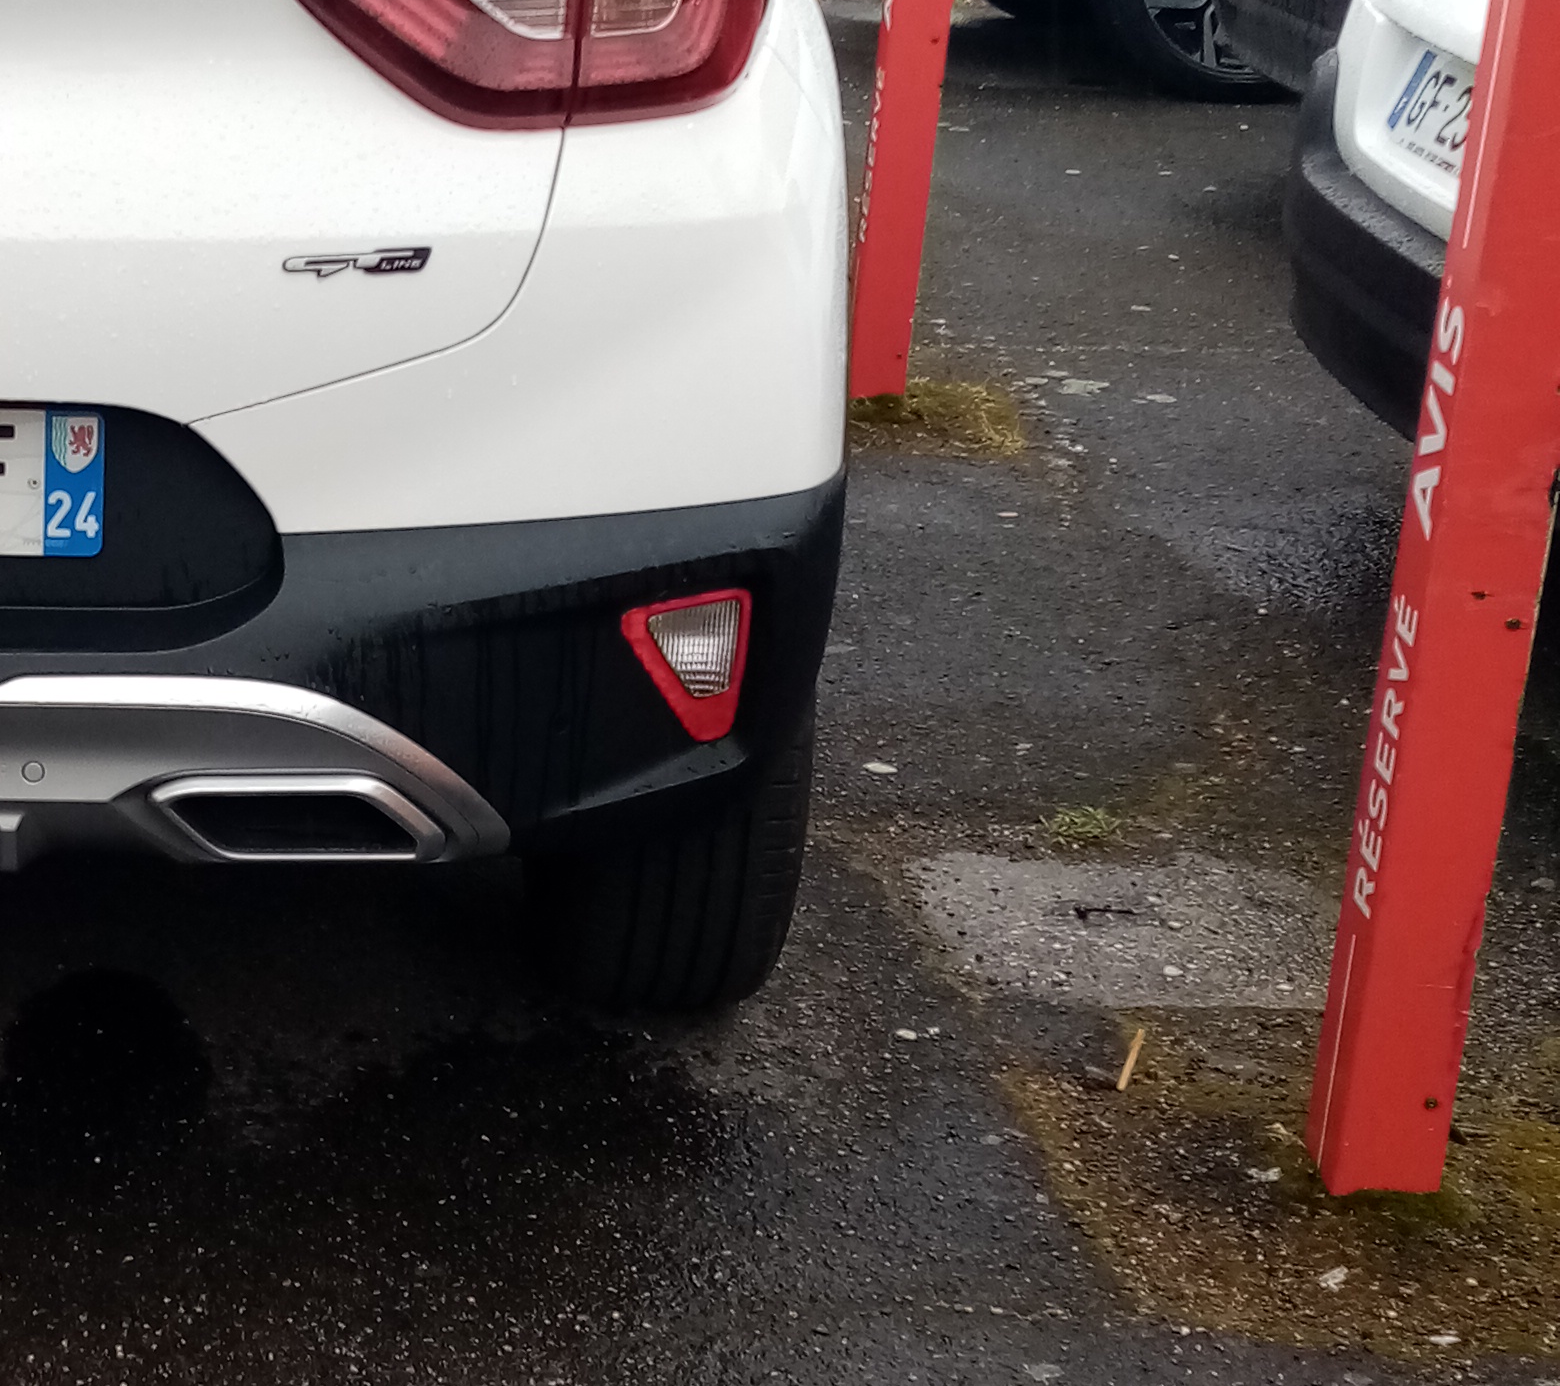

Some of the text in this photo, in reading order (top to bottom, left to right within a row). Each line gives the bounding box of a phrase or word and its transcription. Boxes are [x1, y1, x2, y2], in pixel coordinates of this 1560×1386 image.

[45, 489, 101, 541] 24
[1409, 297, 1465, 542] AVIS
[1351, 594, 1419, 919] RÉSERVÉ
